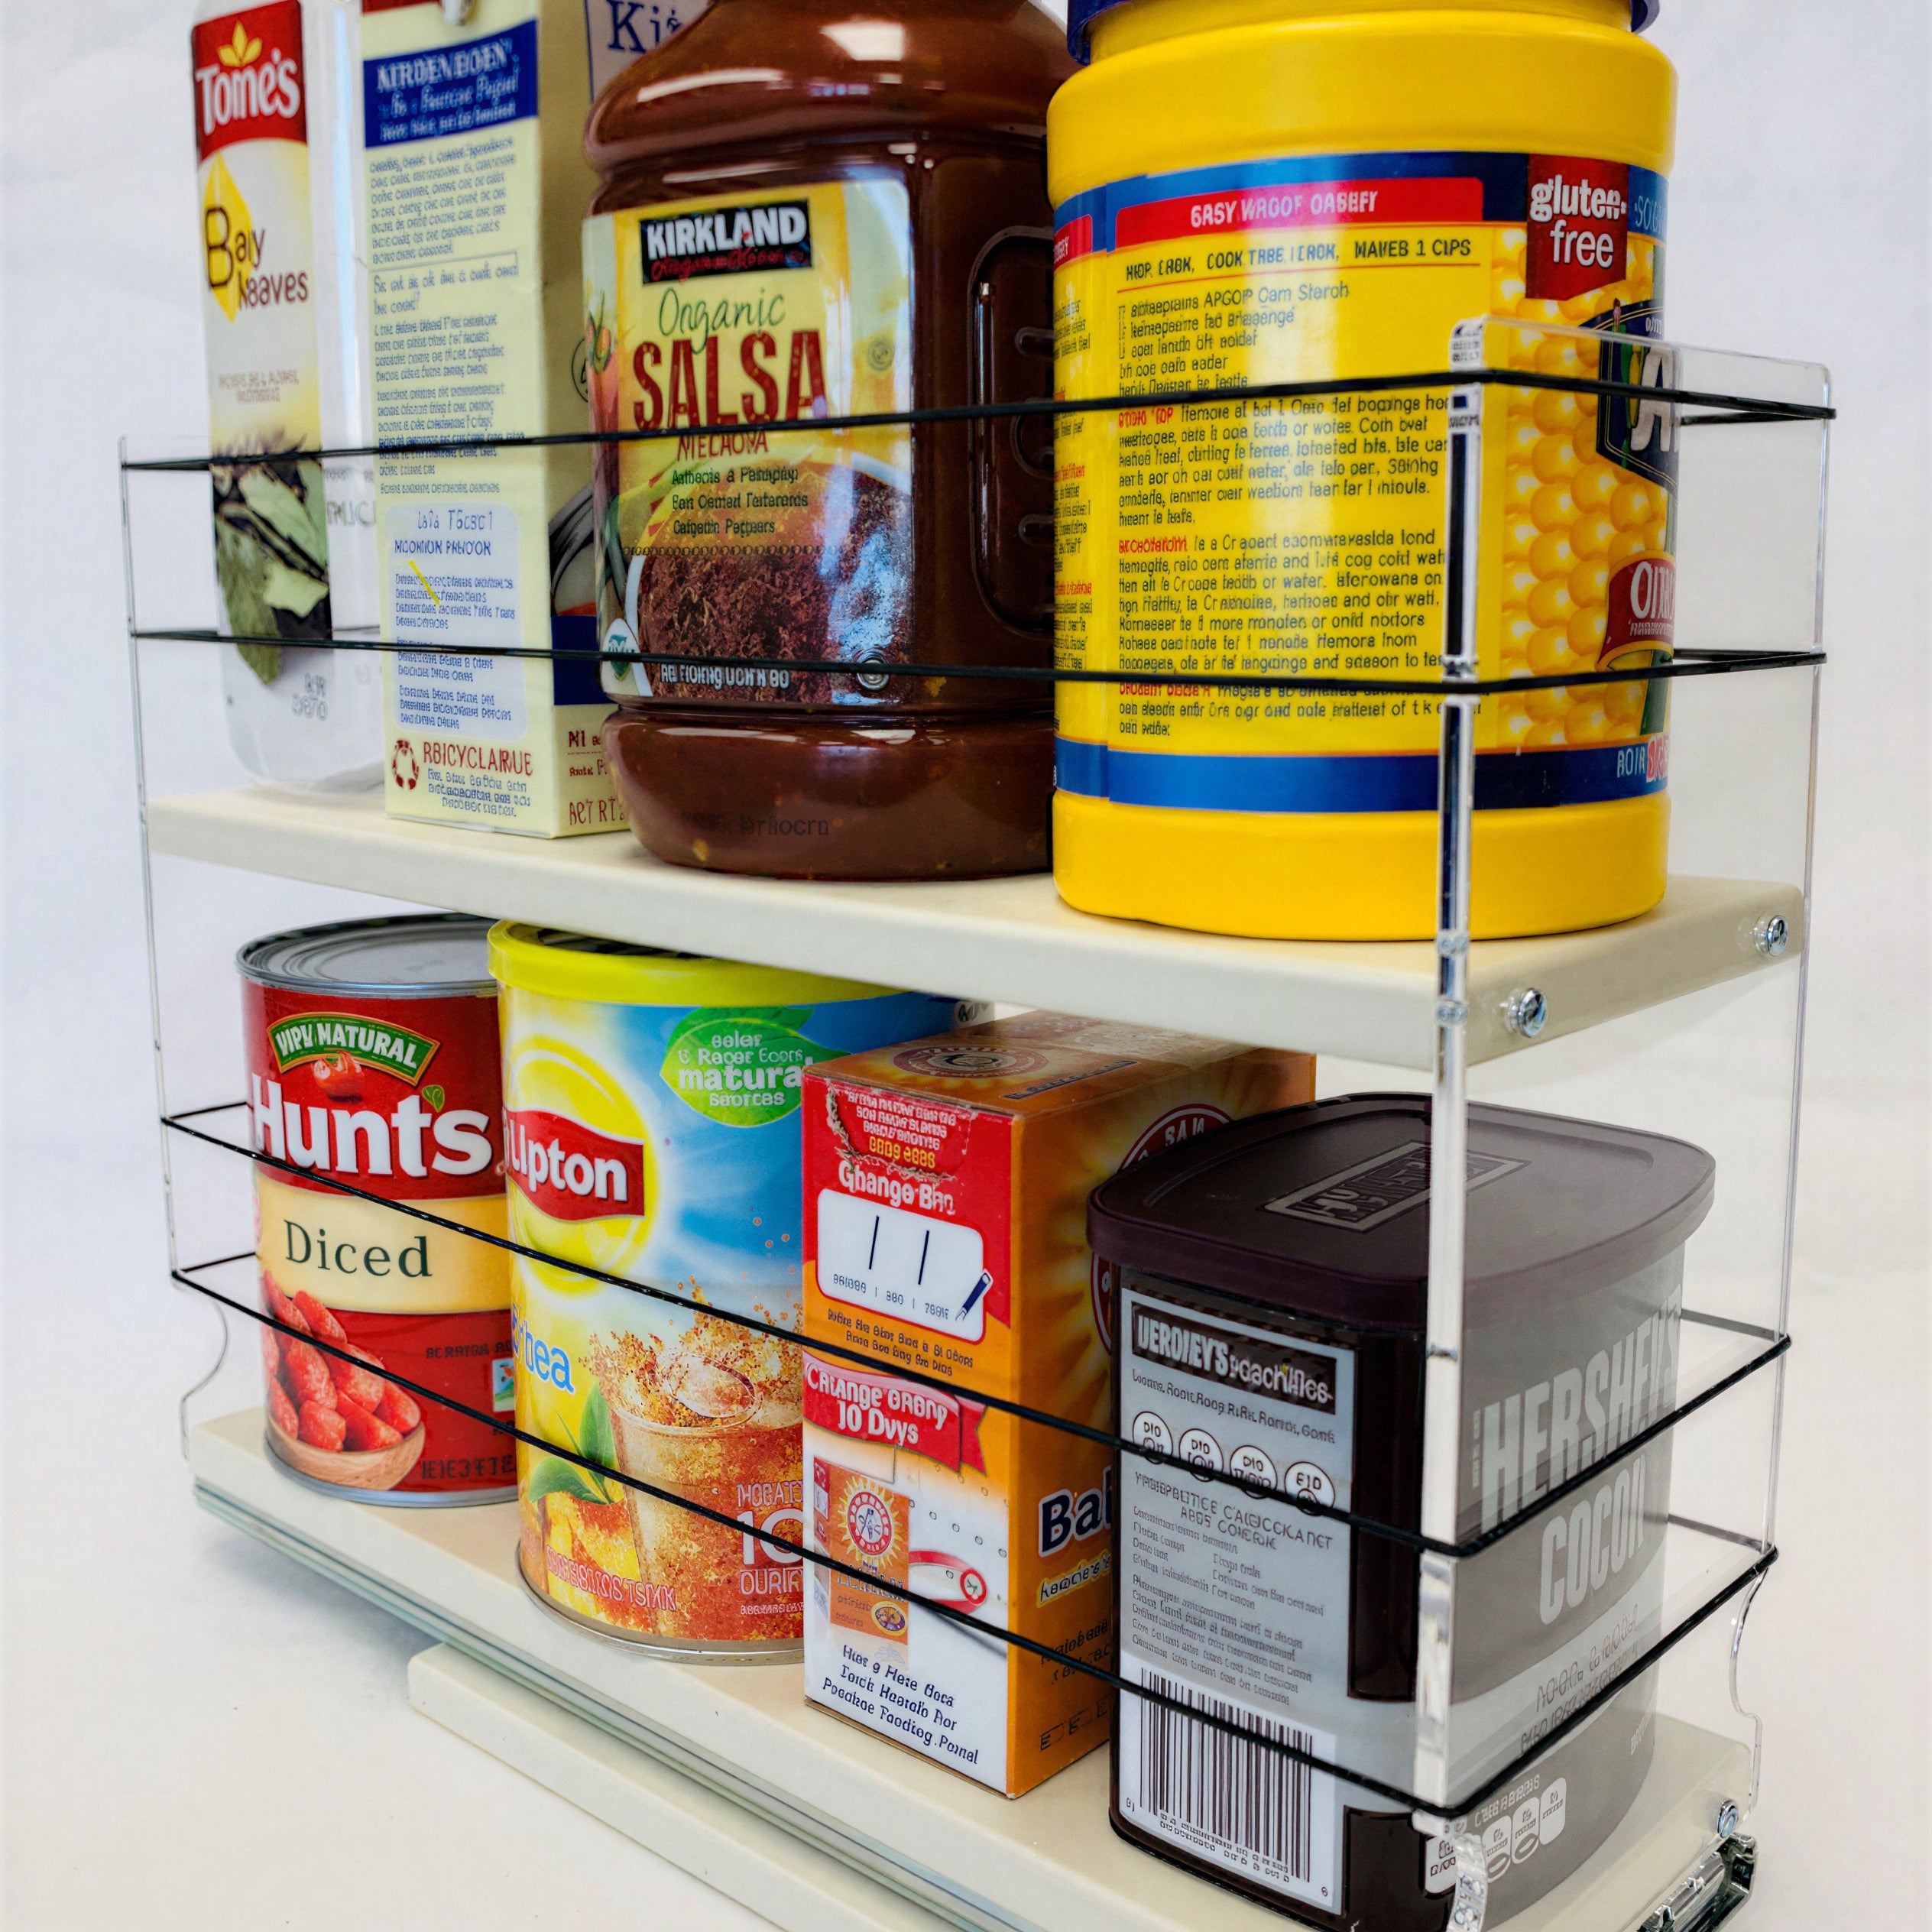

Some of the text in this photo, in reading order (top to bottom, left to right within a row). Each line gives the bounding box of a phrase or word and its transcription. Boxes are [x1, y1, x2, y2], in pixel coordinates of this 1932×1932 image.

[647, 207, 808, 261] KIRKLAND
[1550, 220, 1614, 268] free
[659, 286, 786, 355] Organic
[632, 329, 829, 433] SALSA
[284, 1219, 433, 1279] Diced
